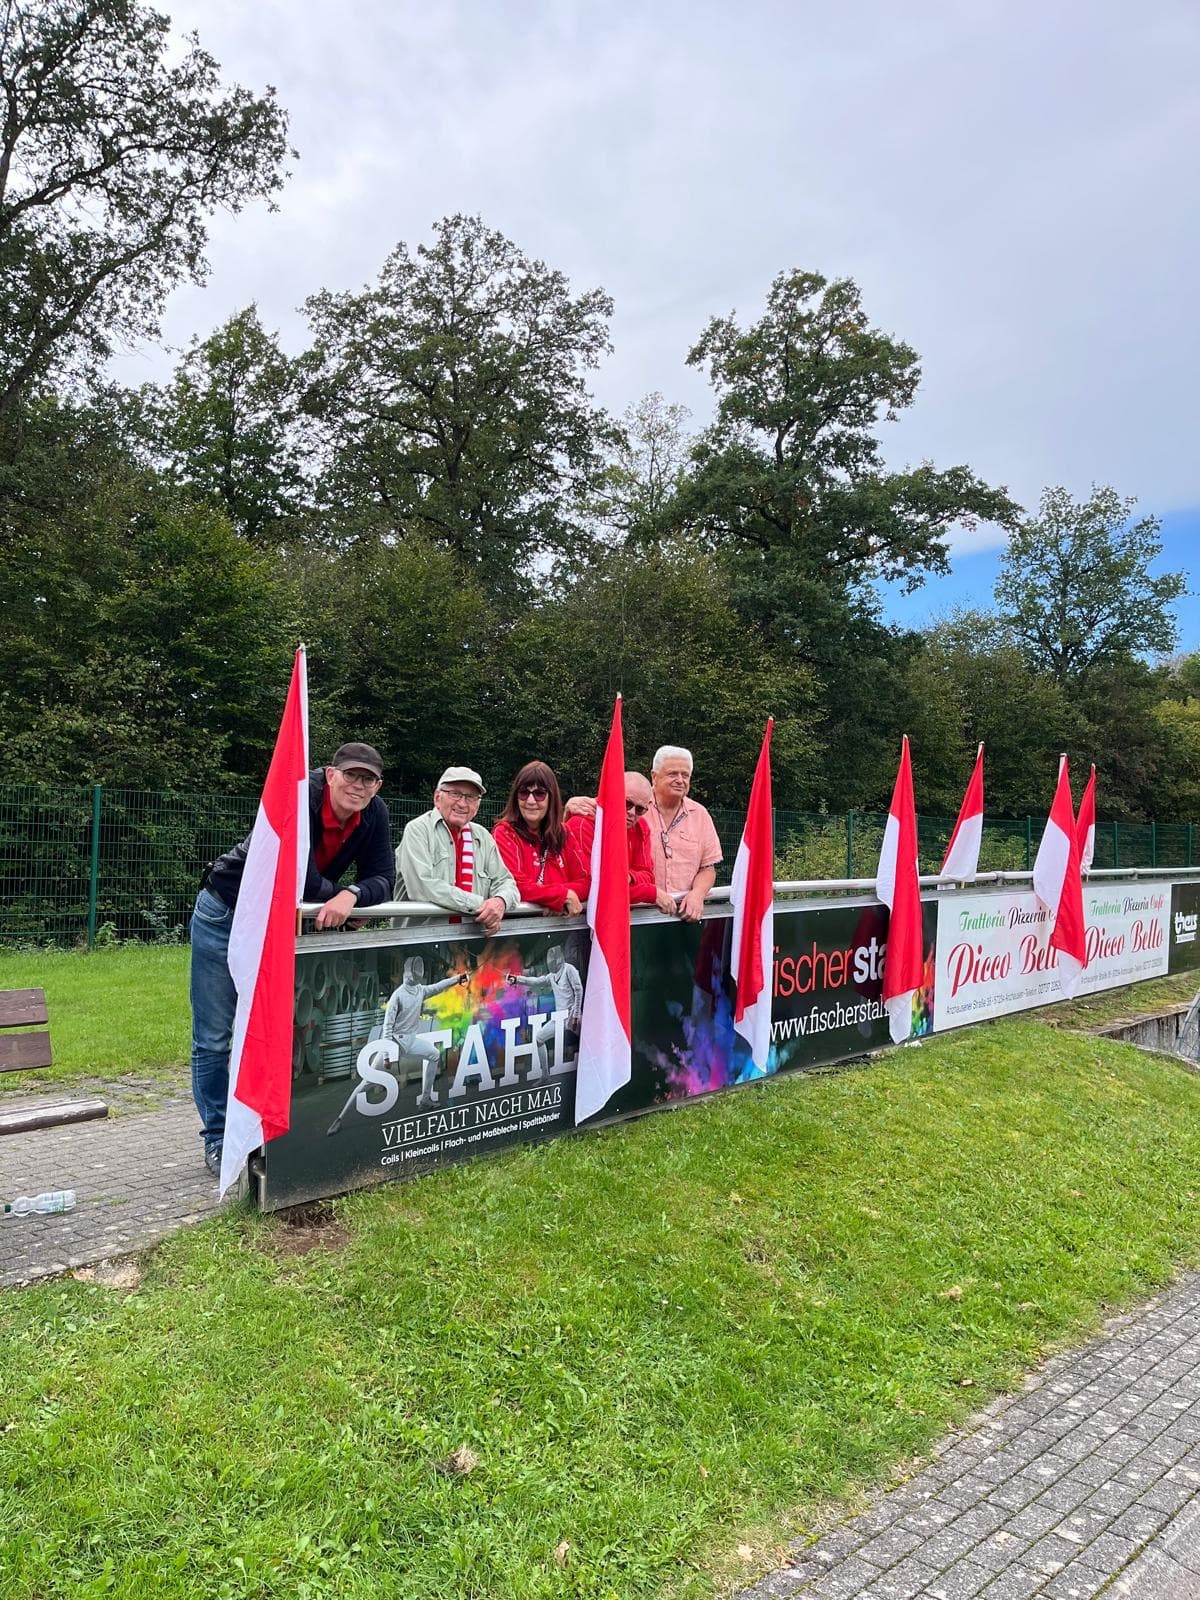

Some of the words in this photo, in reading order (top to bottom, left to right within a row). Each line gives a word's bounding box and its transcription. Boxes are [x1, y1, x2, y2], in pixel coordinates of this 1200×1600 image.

[960, 910, 1006, 931] Trattoria
[1008, 906, 1046, 929] Pizzeria
[1090, 900, 1121, 916] Trattoria
[1123, 896, 1149, 915] Pizzeria
[773, 937, 886, 997] ischersta
[947, 943, 1012, 998] Picco
[1019, 934, 1060, 975] Bell
[1082, 926, 1125, 970] Picco
[1131, 918, 1164, 953] Bello
[356, 1009, 577, 1117] STAHL
[381, 1153, 399, 1166] Coils
[405, 1143, 440, 1160] Kleincoils
[444, 1136, 466, 1149] Flach-
[467, 1132, 481, 1143] und
[482, 1123, 518, 1139] Maßbleche
[522, 1112, 561, 1131] Spaltbänder
[382, 1108, 469, 1146] VIELFALT
[475, 1095, 522, 1124] NACH
